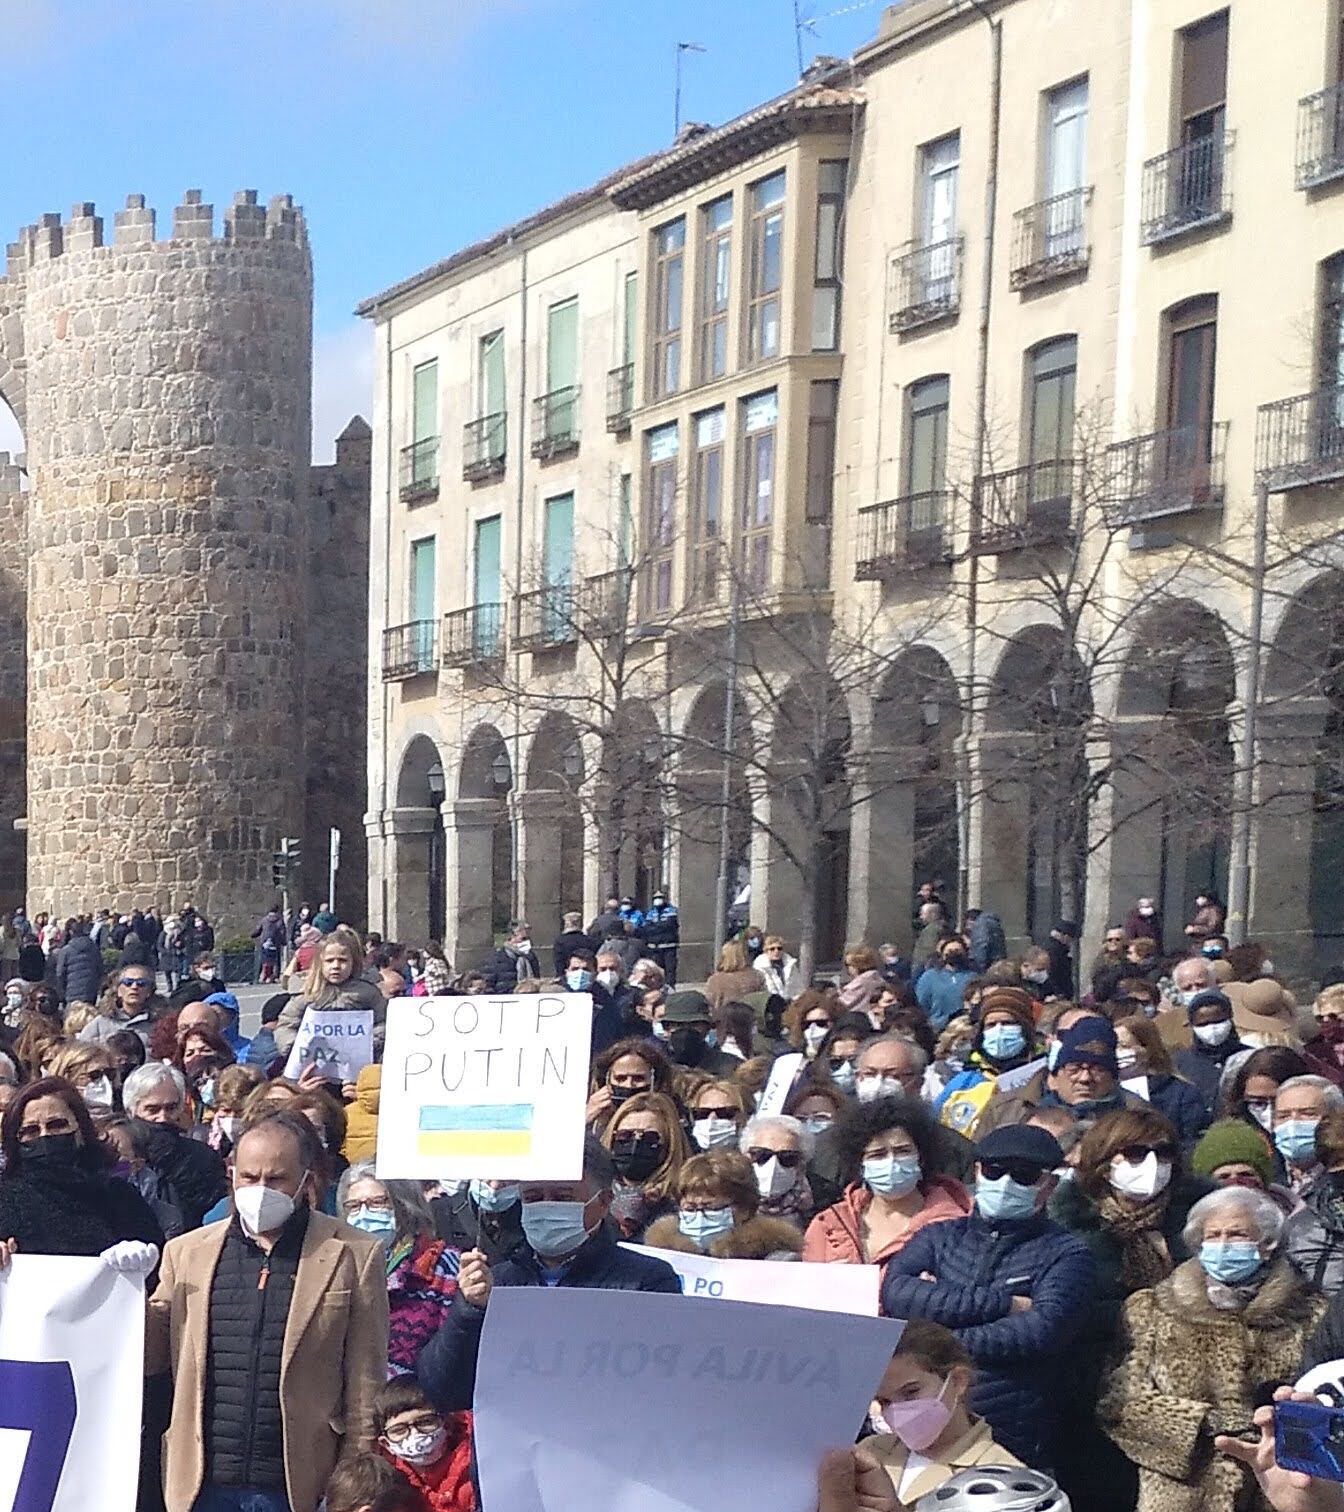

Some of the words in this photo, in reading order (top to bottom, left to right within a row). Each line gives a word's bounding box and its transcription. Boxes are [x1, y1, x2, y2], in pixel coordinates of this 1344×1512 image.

[415, 998, 565, 1036] SOTP
[314, 1024, 343, 1036] POR
[348, 1024, 365, 1036] LA
[299, 1046, 340, 1063] PAZ
[404, 1046, 568, 1091] PUTIN
[694, 1277, 724, 1296] PO
